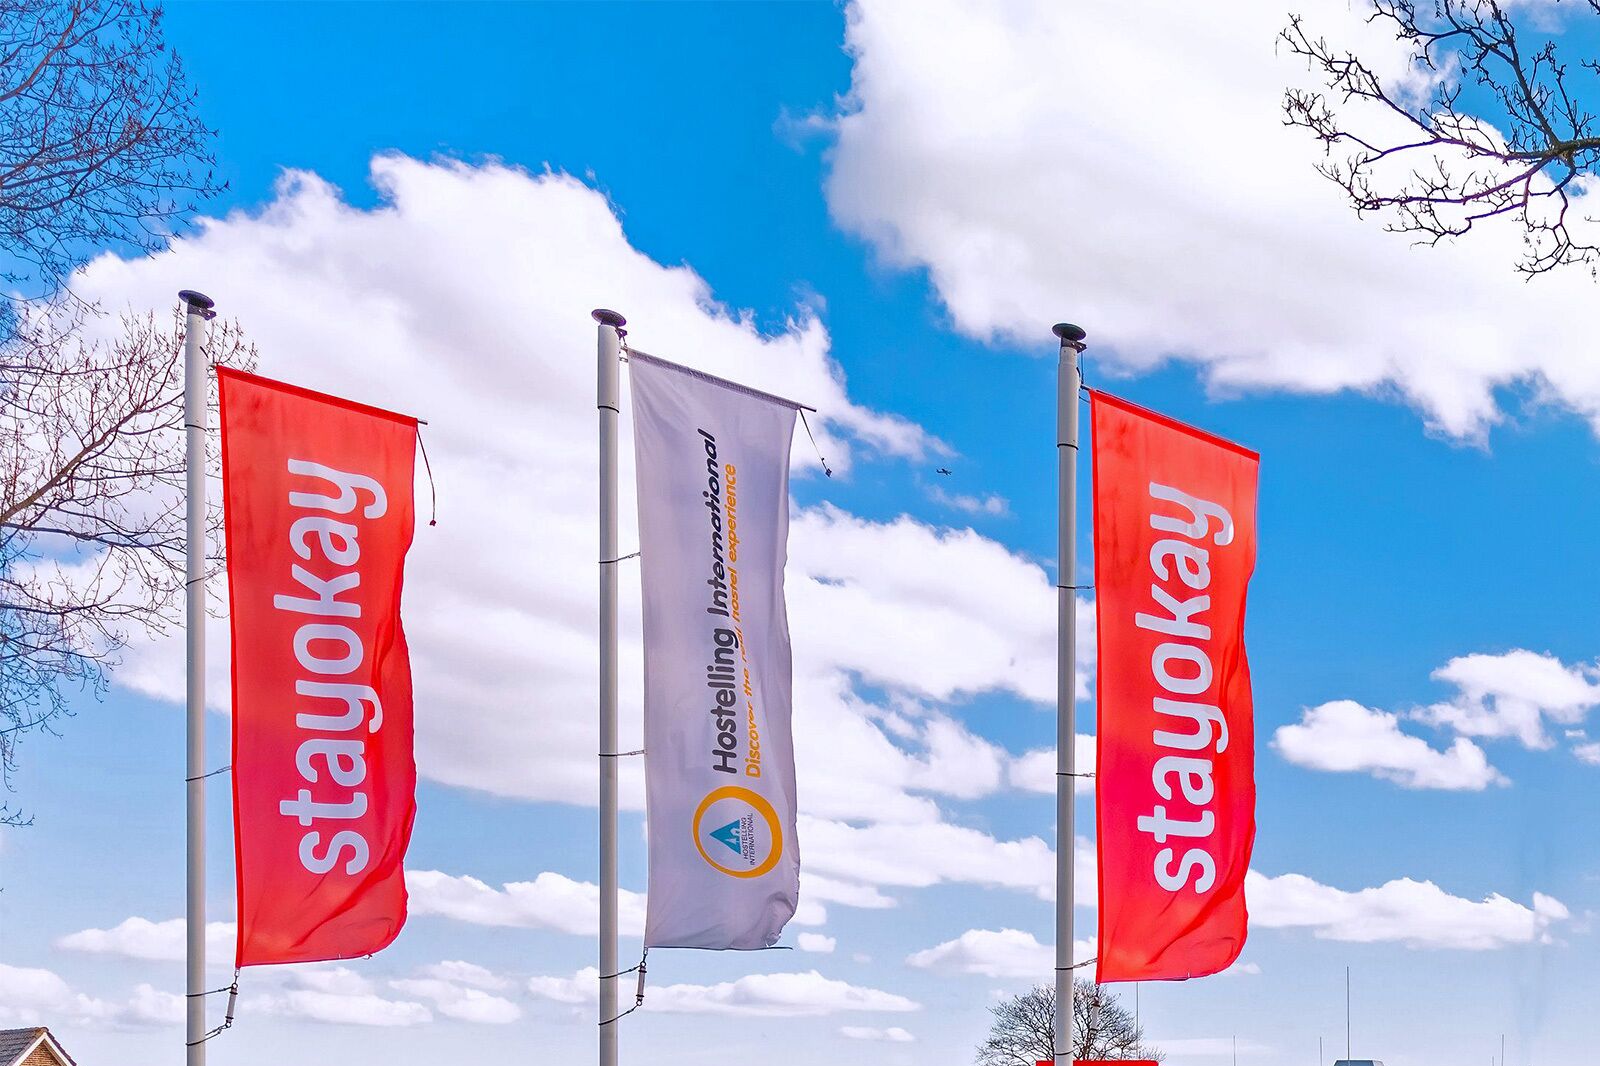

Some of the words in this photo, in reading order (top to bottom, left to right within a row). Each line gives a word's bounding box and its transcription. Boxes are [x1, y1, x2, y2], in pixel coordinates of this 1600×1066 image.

[697, 428, 730, 618] International
[723, 463, 741, 564] experience
[726, 565, 742, 623] hostel
[273, 458, 388, 876] stayokay
[735, 627, 747, 663] real
[742, 667, 753, 698] the
[706, 628, 739, 774] Hostelling
[1135, 481, 1235, 894] stayokay
[744, 700, 762, 779] Discover
[741, 816, 749, 860] HOSTELLING
[747, 813, 756, 866] INTERNATIONAL
